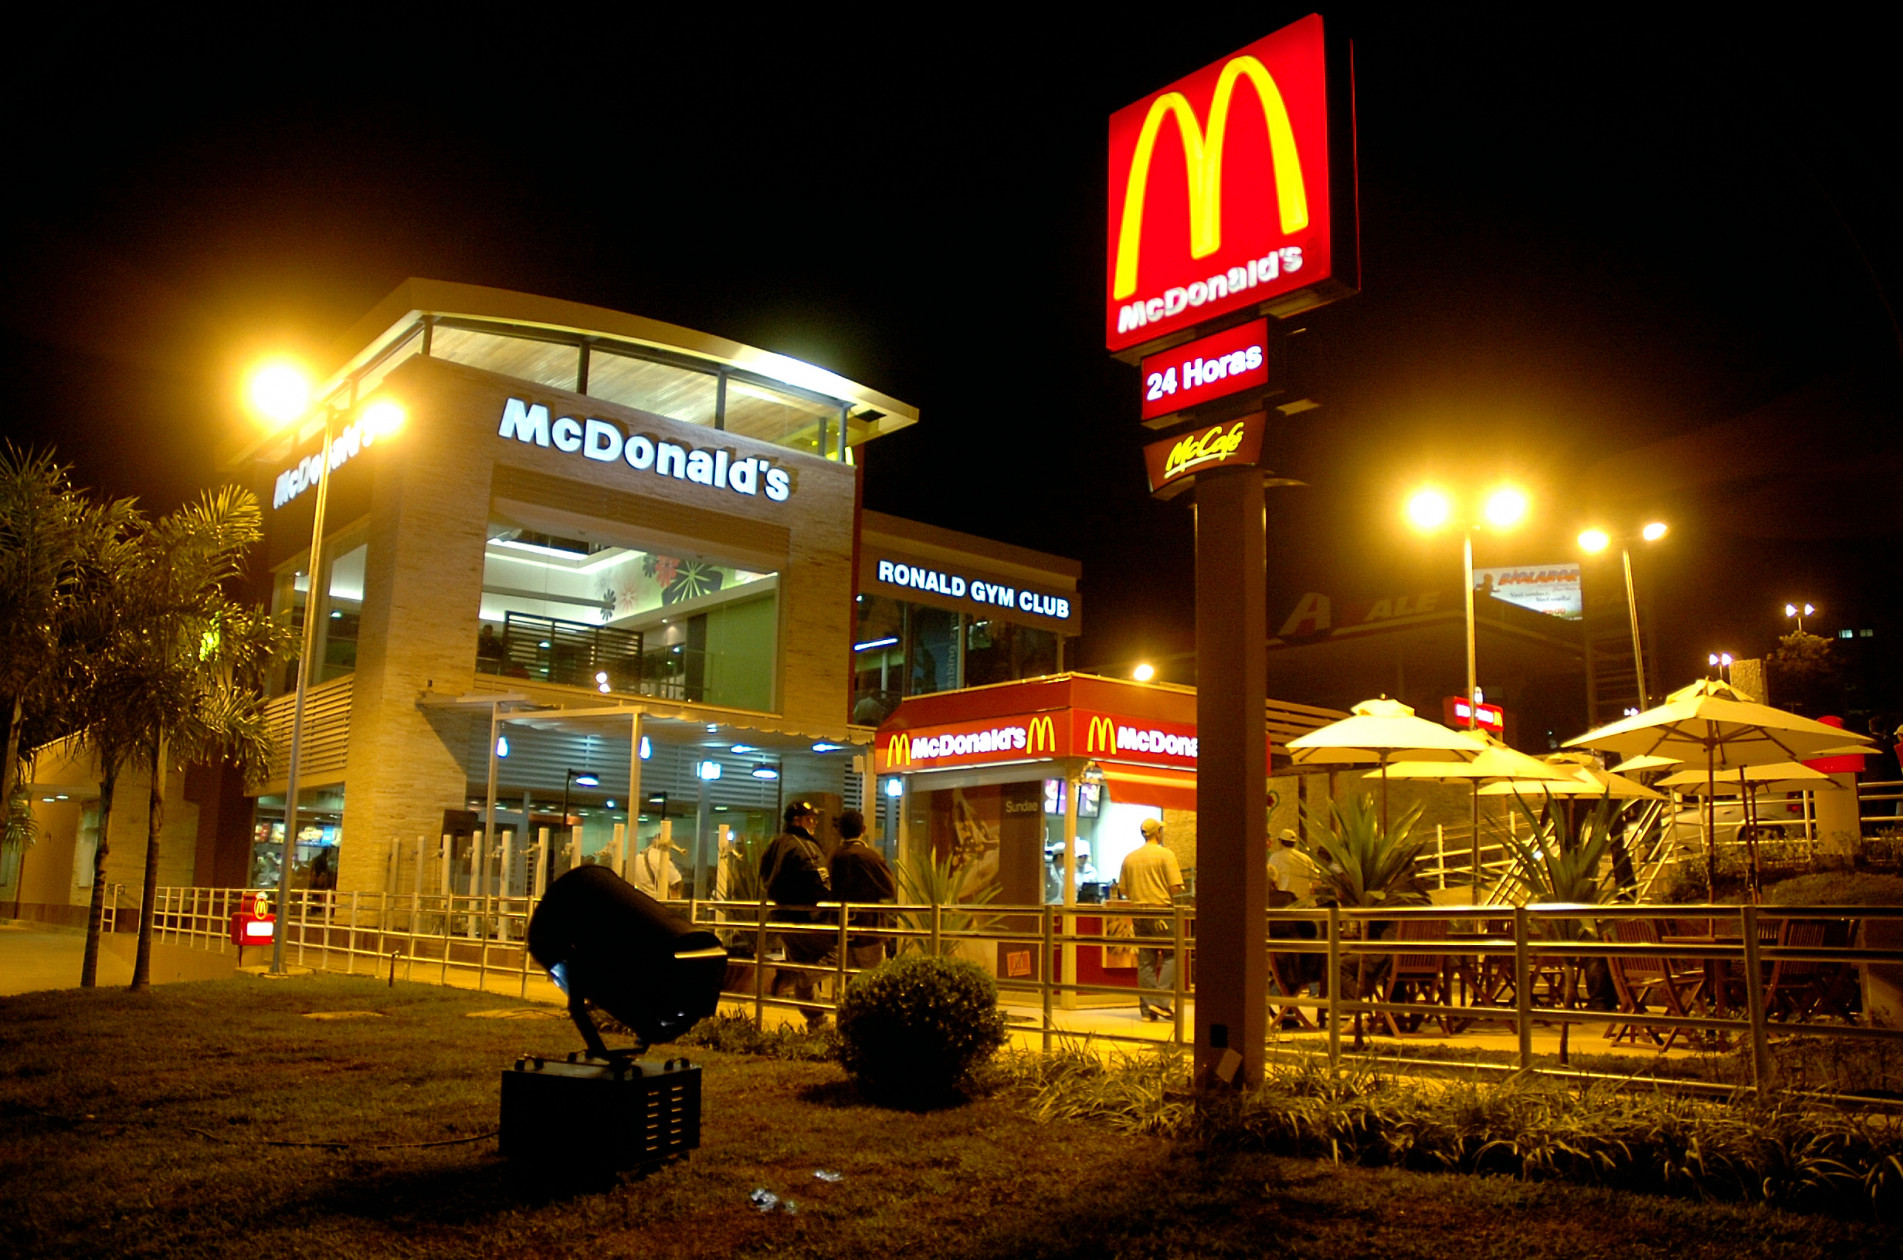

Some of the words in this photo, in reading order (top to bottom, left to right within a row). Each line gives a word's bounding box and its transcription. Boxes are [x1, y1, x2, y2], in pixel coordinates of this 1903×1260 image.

[1117, 246, 1304, 334] McDonald's
[1146, 366, 1178, 401] 24
[1182, 345, 1263, 390] Horas
[498, 396, 790, 502] McDonald's
[878, 559, 967, 598] RONALD
[969, 580, 1015, 608] GYM
[1018, 590, 1070, 619] CLUB
[910, 727, 1027, 760] McDonald's
[1005, 800, 1039, 813] Sundae
